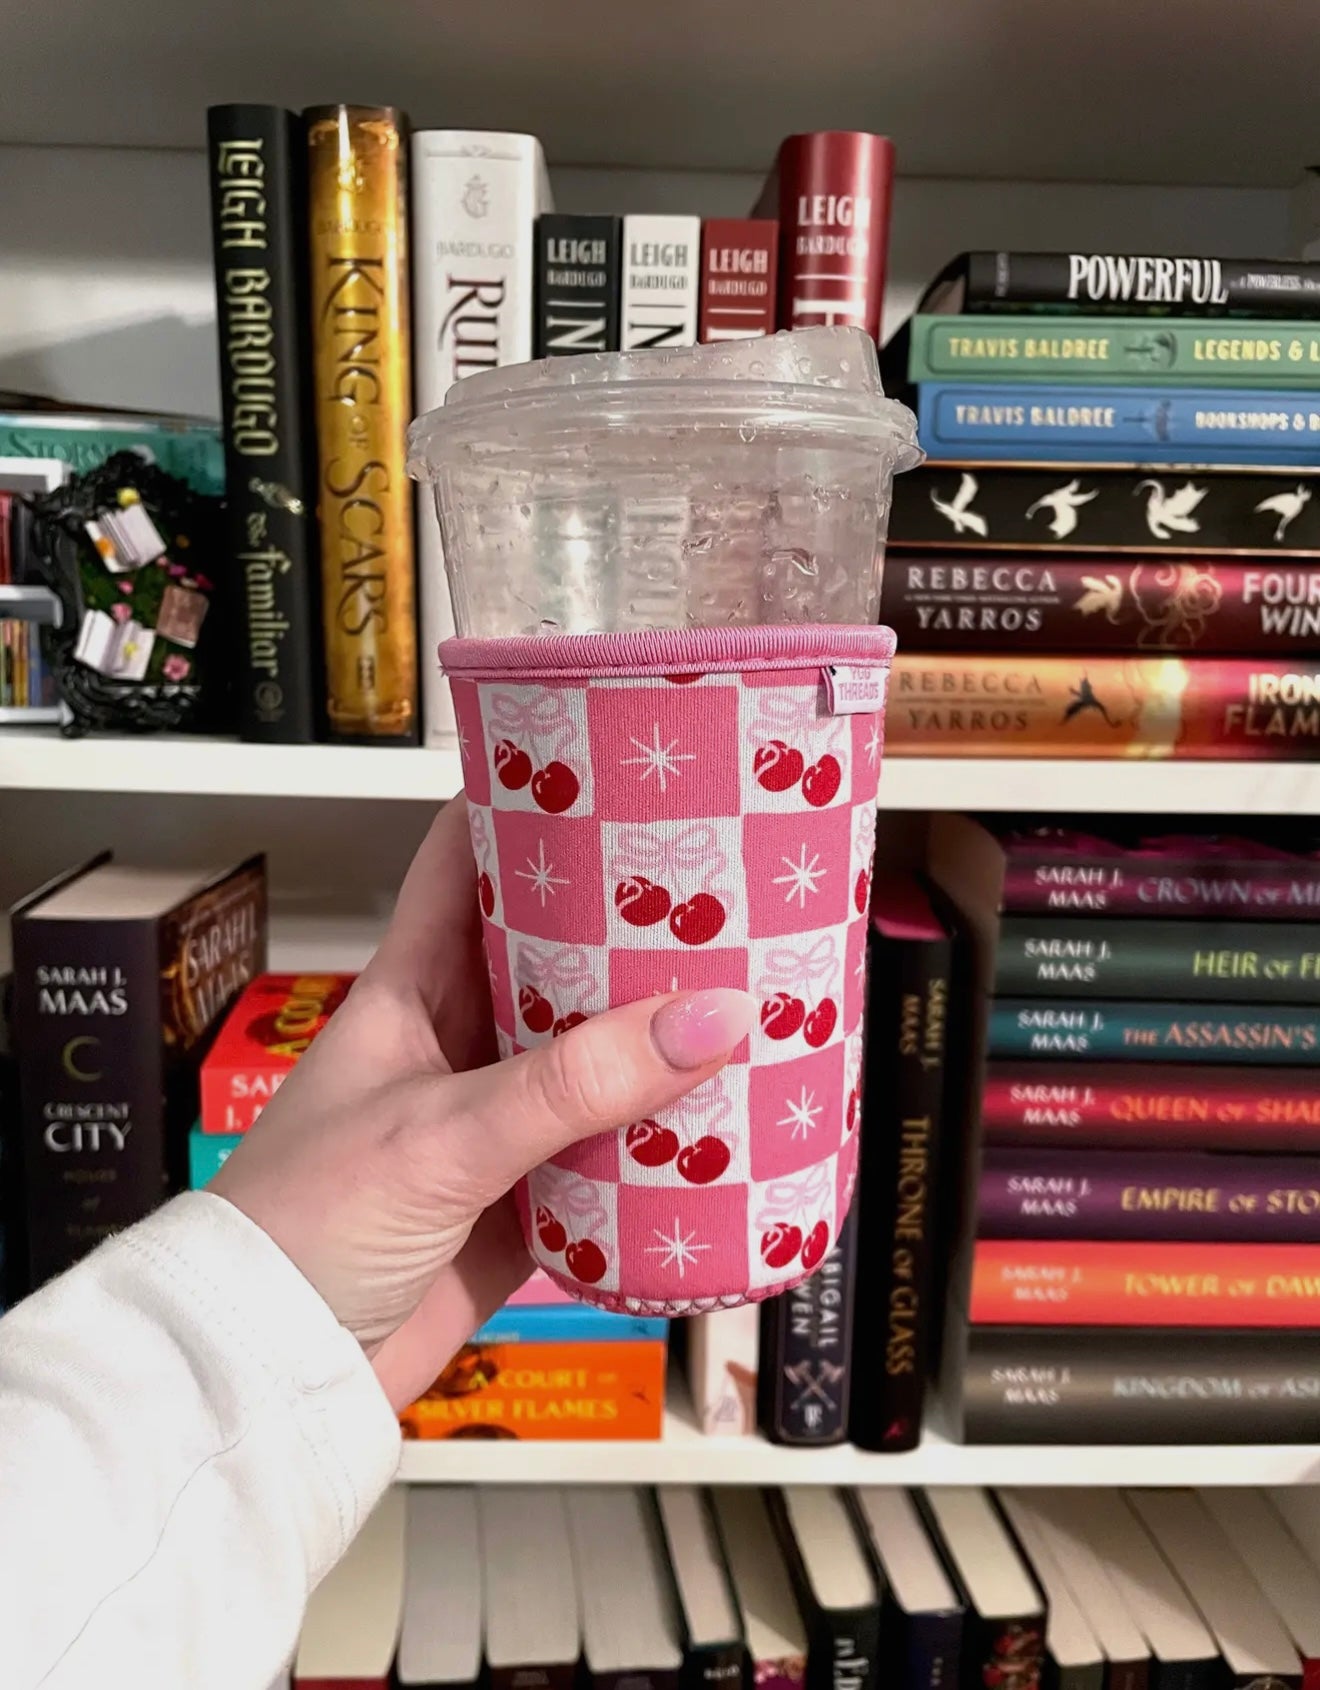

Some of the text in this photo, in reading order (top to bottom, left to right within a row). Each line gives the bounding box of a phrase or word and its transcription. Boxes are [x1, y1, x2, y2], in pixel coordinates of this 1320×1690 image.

[797, 194, 872, 228] LEIGH
[436, 241, 516, 259] BARDUGO
[546, 237, 607, 265] LEIGH
[630, 243, 689, 268] LEIGH
[709, 248, 769, 274] LEIGH
[546, 269, 607, 287] BARDUGO
[630, 273, 688, 291] BARDUGO
[708, 278, 769, 297] BARDUGO
[1067, 254, 1230, 304] POWERFUL
[217, 137, 279, 455] LEIGH BARDUGO
[318, 256, 384, 406] KING
[948, 337, 1110, 360] TRAVIS BALDREE
[1194, 338, 1281, 361] LEGENDS
[1287, 339, 1303, 361] &
[955, 405, 1116, 428] TRAVIS BALDREE
[1195, 411, 1289, 431] BOOKSHOPS
[1292, 412, 1305, 431] &
[325, 459, 390, 638] SCARS
[906, 566, 1057, 593] REBECCA
[1242, 571, 1320, 605] FOUR
[238, 545, 292, 678] familiar
[916, 606, 1042, 632] YARROS
[899, 671, 1044, 695] REBECCA
[1248, 673, 1320, 706] IRON
[907, 709, 1029, 732] YARROS
[1035, 866, 1104, 886] SARAH
[1048, 890, 1107, 909] MAAS
[1137, 877, 1250, 905] CROWN
[1024, 938, 1092, 958] SARAH
[1037, 963, 1096, 982] MAAS
[1192, 951, 1258, 978] HEIR
[1263, 960, 1292, 979] OF
[36, 967, 107, 987] SARAH
[38, 989, 129, 1016] MAAS
[1017, 1009, 1085, 1030] SARAH
[1030, 1033, 1089, 1052] MAAS
[1123, 1022, 1317, 1050] THE ASSASSIN'S
[1010, 1083, 1077, 1104] SARAH
[43, 1102, 129, 1121] CRESCENT
[1023, 1107, 1081, 1126] MAAS
[1110, 1095, 1209, 1122] QUEEN
[1216, 1103, 1247, 1122] OF
[44, 1122, 132, 1153] CITY
[1007, 1176, 1073, 1196] SARAH
[1021, 1198, 1078, 1217] MAAS
[1121, 1186, 1220, 1213] EMPIRE
[1228, 1194, 1257, 1213] OF
[885, 1115, 929, 1375] THRONE OF GLASS
[1001, 1266, 1066, 1283] SARAH
[1124, 1272, 1220, 1297] TOWER
[1228, 1279, 1255, 1297] OF
[1013, 1286, 1069, 1302] MAAS
[468, 1370, 489, 1389] A
[497, 1369, 587, 1390] COURT
[991, 1368, 1054, 1386] SARAH
[1113, 1375, 1241, 1399] KINGDOM
[1004, 1388, 1060, 1405] MAAS
[416, 1400, 618, 1421] SILVER FLAMES
